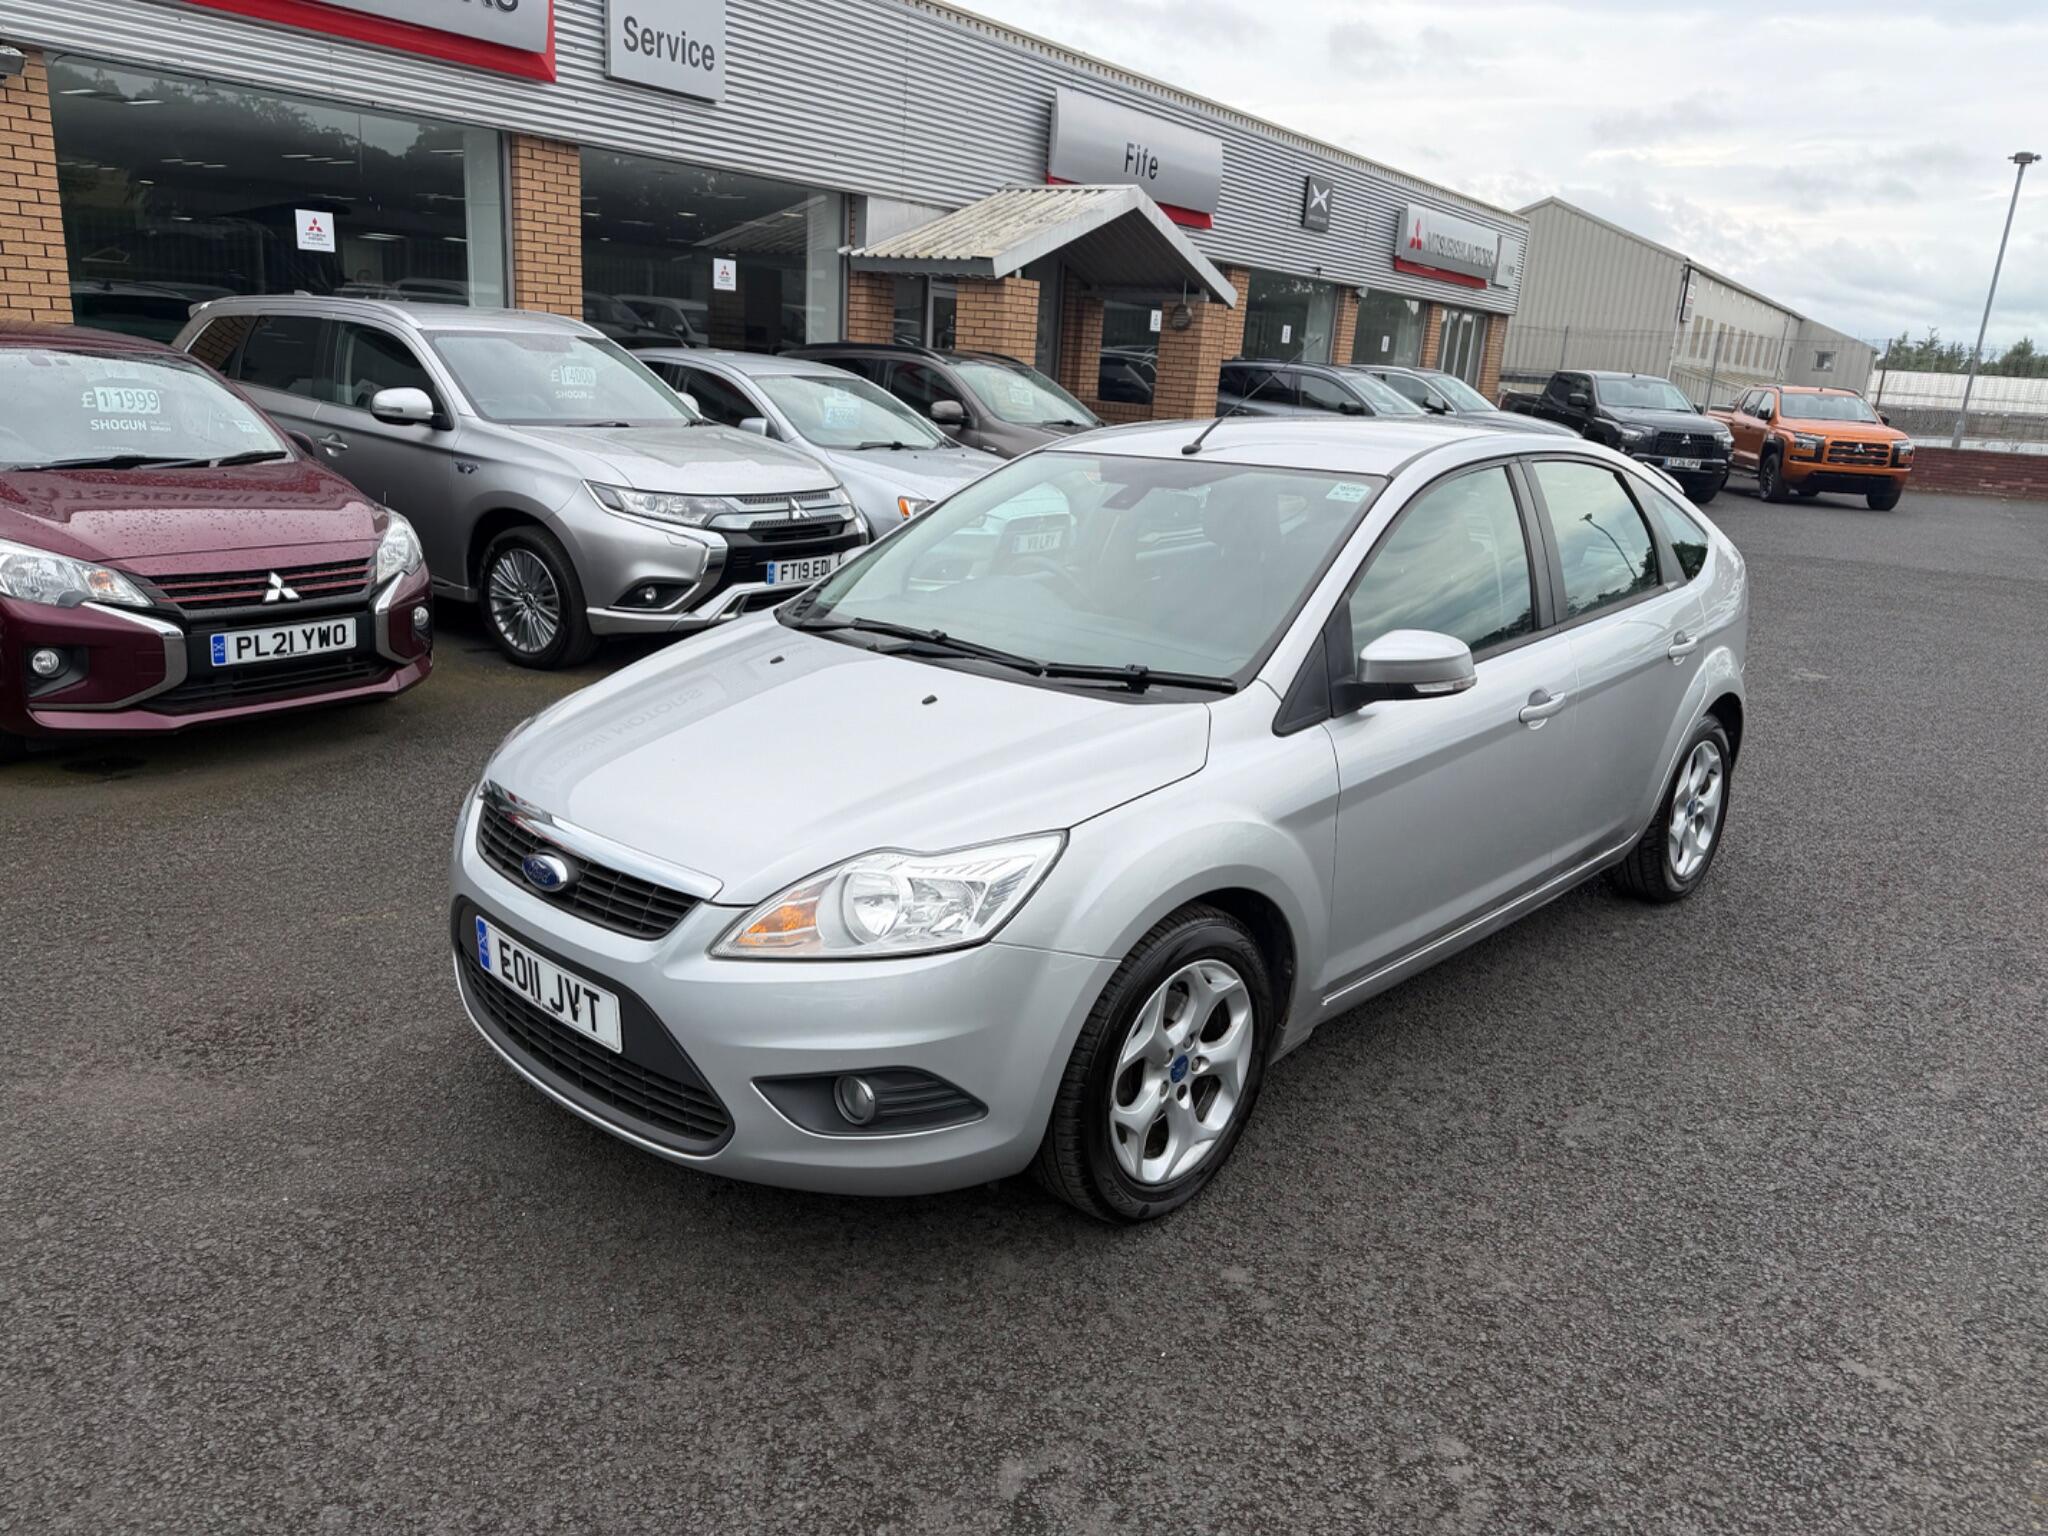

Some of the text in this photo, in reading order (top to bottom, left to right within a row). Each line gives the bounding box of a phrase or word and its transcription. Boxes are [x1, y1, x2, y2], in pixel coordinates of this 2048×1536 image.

[623, 16, 715, 71] Service
[1124, 142, 1158, 180] Fife
[91, 420, 147, 431] SHOGUN
[781, 562, 809, 581] FT19
[236, 624, 346, 659] PL21 YWO
[499, 938, 600, 1033] EO11 JVT
